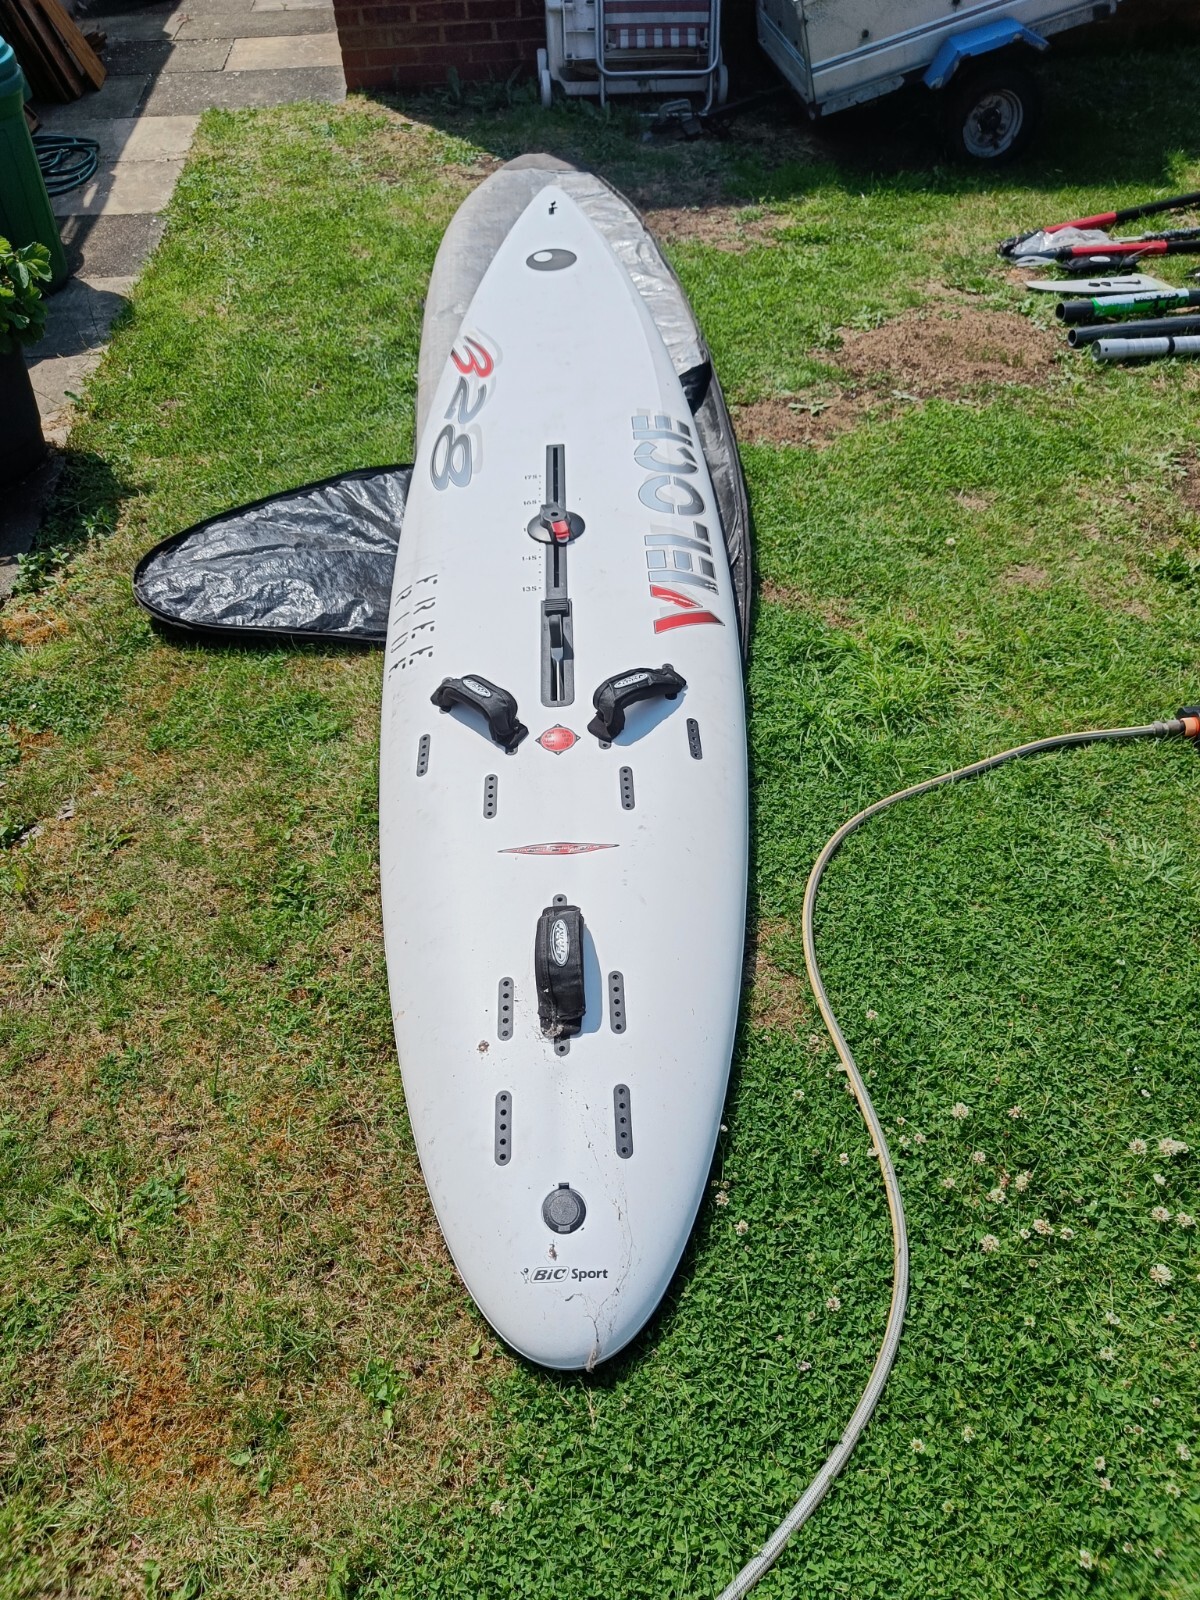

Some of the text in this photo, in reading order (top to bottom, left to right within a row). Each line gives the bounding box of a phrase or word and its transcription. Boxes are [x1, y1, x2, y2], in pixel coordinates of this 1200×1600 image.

[430, 336, 494, 492] 328
[631, 413, 725, 634] VELOCE
[388, 584, 412, 682] RIDE
[409, 573, 438, 665] FREE
[571, 1268, 608, 1282] Sport
